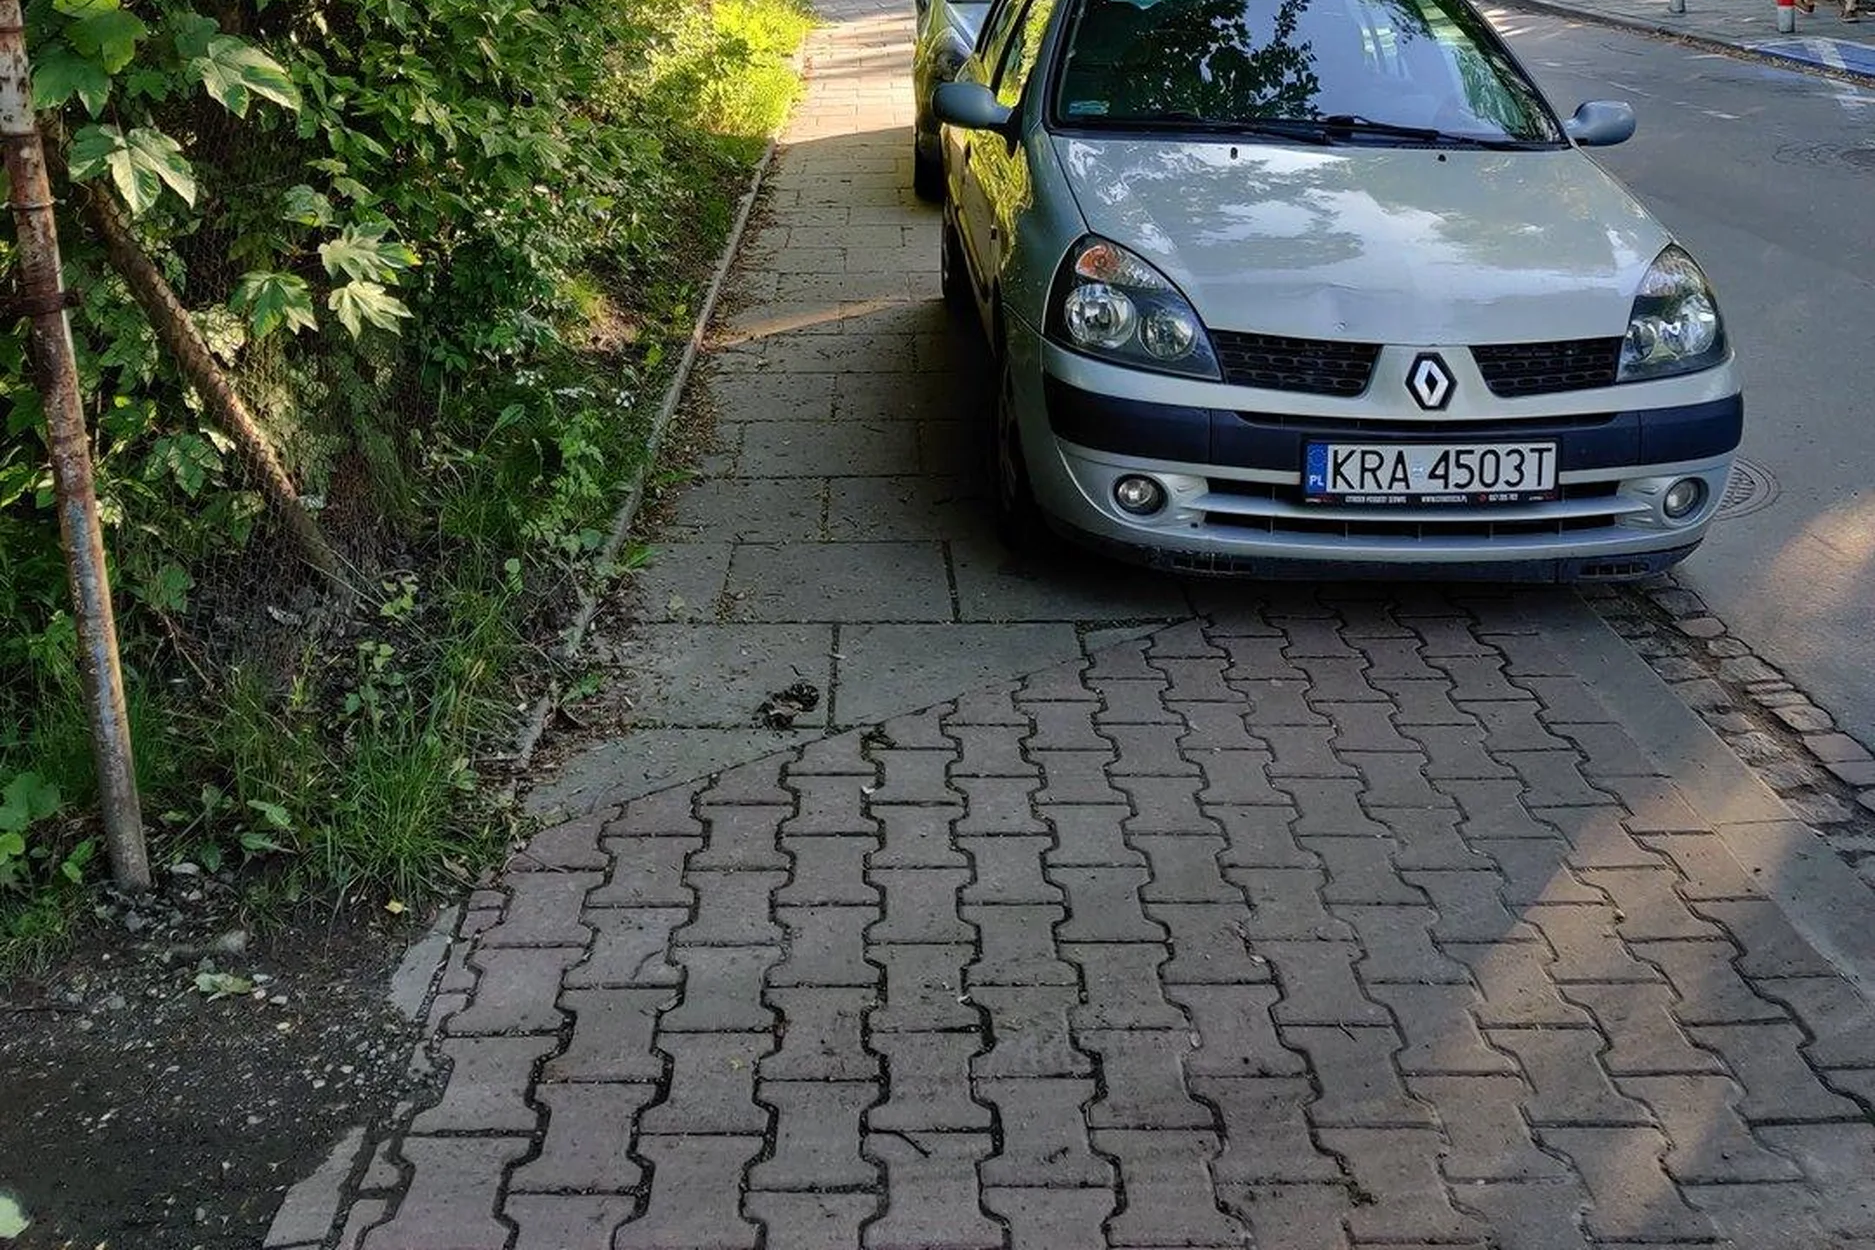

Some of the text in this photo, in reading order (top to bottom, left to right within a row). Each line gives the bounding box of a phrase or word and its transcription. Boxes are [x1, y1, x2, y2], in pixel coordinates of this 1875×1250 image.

[1309, 475, 1324, 487] PL
[1331, 447, 1553, 490] KRA 4503T
